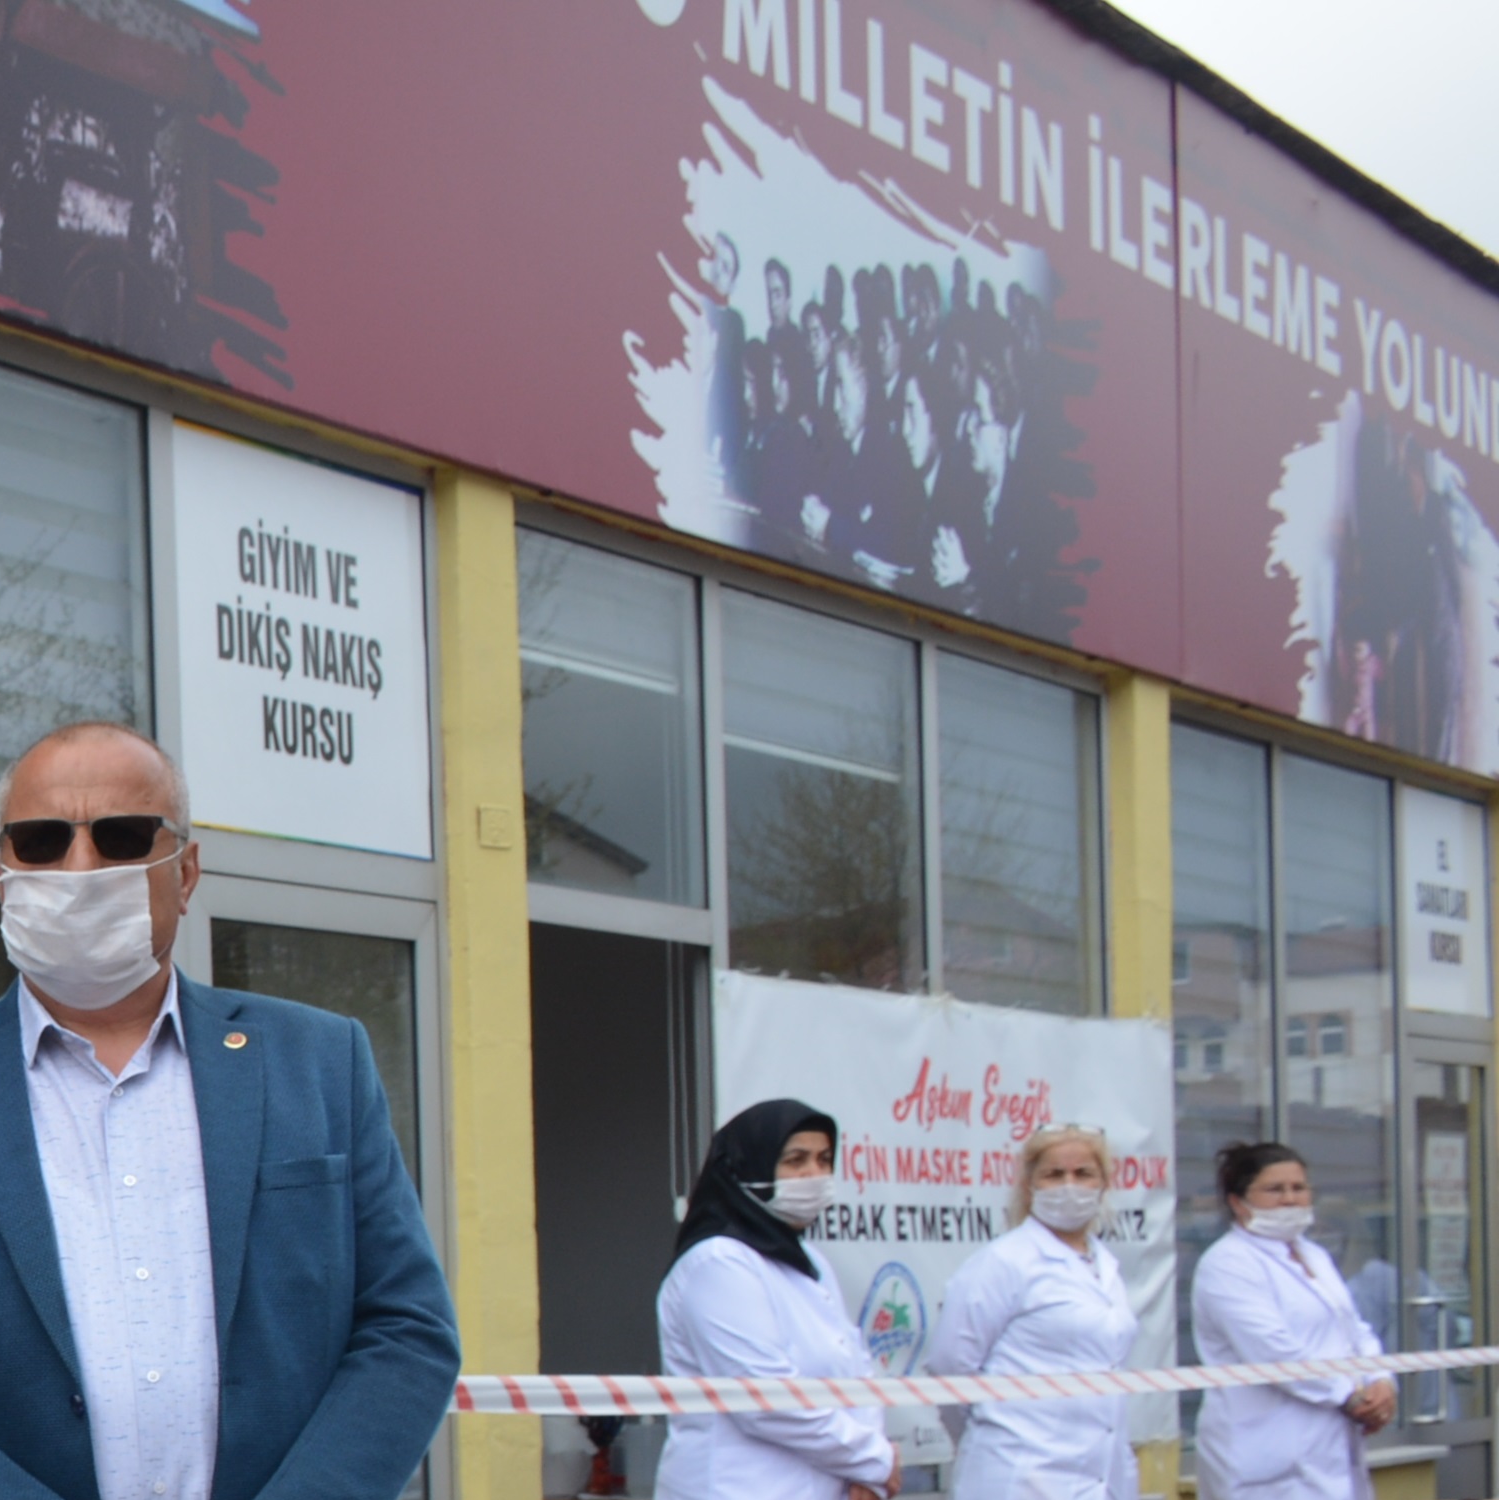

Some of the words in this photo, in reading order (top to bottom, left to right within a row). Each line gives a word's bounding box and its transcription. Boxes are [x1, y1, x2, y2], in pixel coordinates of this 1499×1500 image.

[1087, 114, 1343, 377] İLERLEME
[237, 518, 318, 599] GİYİM
[326, 549, 359, 610] VE
[215, 595, 293, 680] DİKİŞ
[302, 624, 384, 700] NAKIŞ
[262, 695, 354, 766] KURSU
[840, 1134, 890, 1194] İÇİN
[895, 1145, 973, 1186] MASKE
